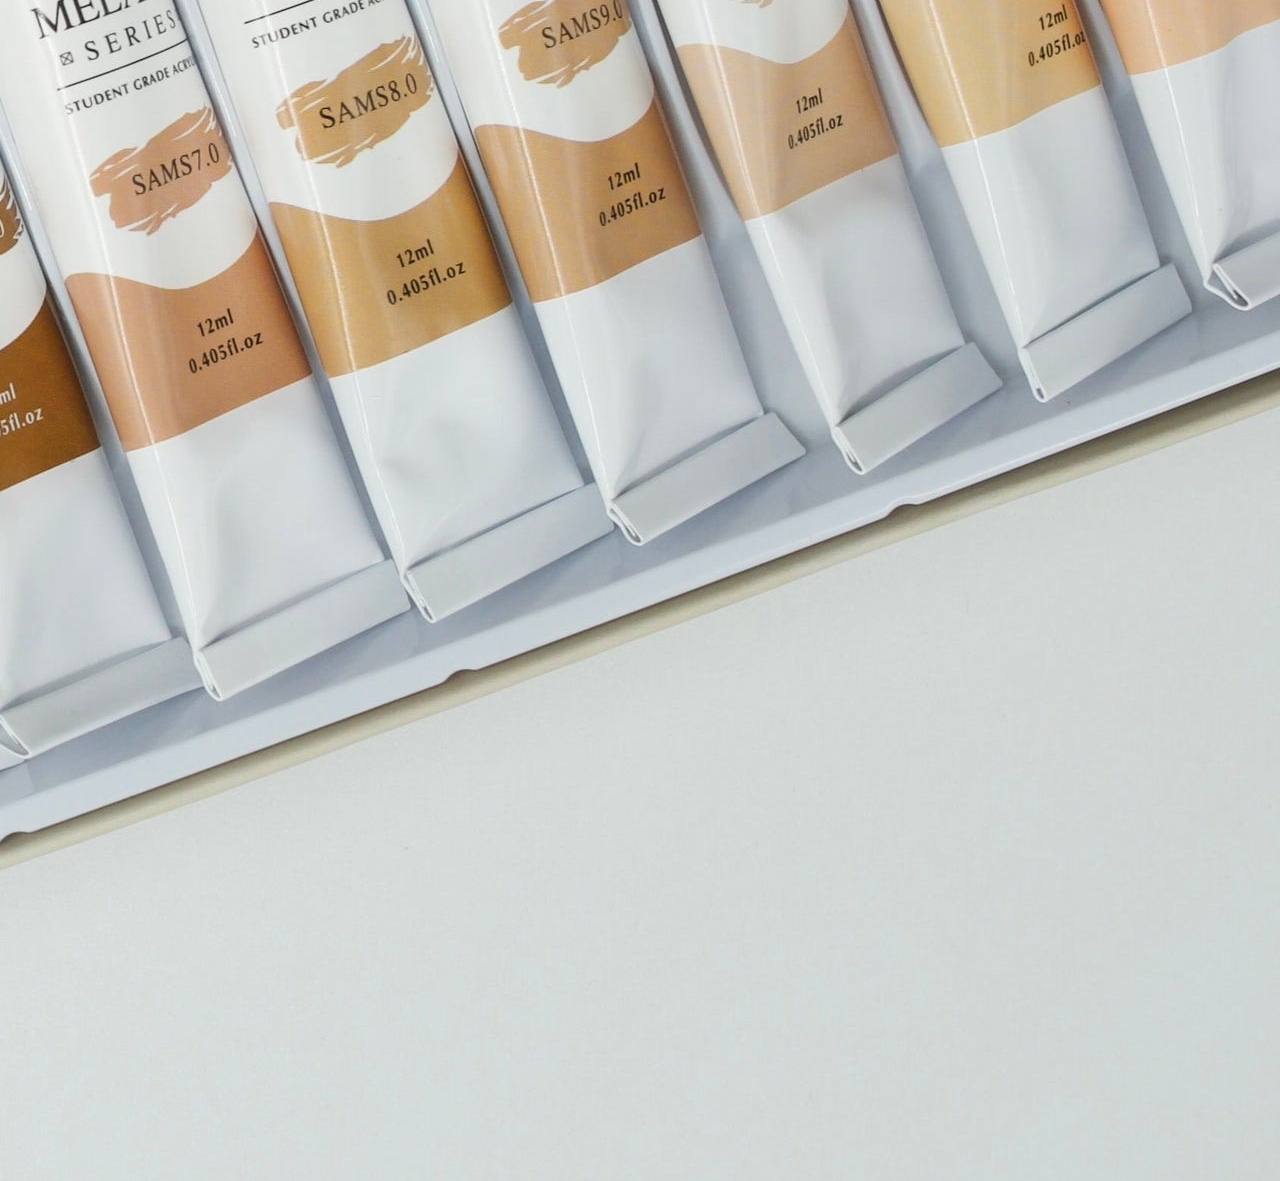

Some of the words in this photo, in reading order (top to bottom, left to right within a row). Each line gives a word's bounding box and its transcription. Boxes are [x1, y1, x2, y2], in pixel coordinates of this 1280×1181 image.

[84, 10, 176, 61] SERIES
[251, 16, 317, 49] STUDENT
[1038, 3, 1068, 31] 12ml
[65, 83, 129, 113] STUDENT
[132, 67, 170, 91] GRADE
[318, 72, 418, 129] SAMS8.0
[795, 87, 824, 114] 12ml
[787, 114, 844, 150] 0.405fl.oz
[131, 142, 220, 196] SAMS7.0
[607, 162, 641, 191] 12ml
[599, 187, 666, 227] 0.405fl.oz
[396, 238, 435, 268] 12ml
[386, 261, 467, 306] 0.405fl.oz
[196, 307, 234, 337] 12ml
[188, 332, 264, 374] 0.405fl.oz
